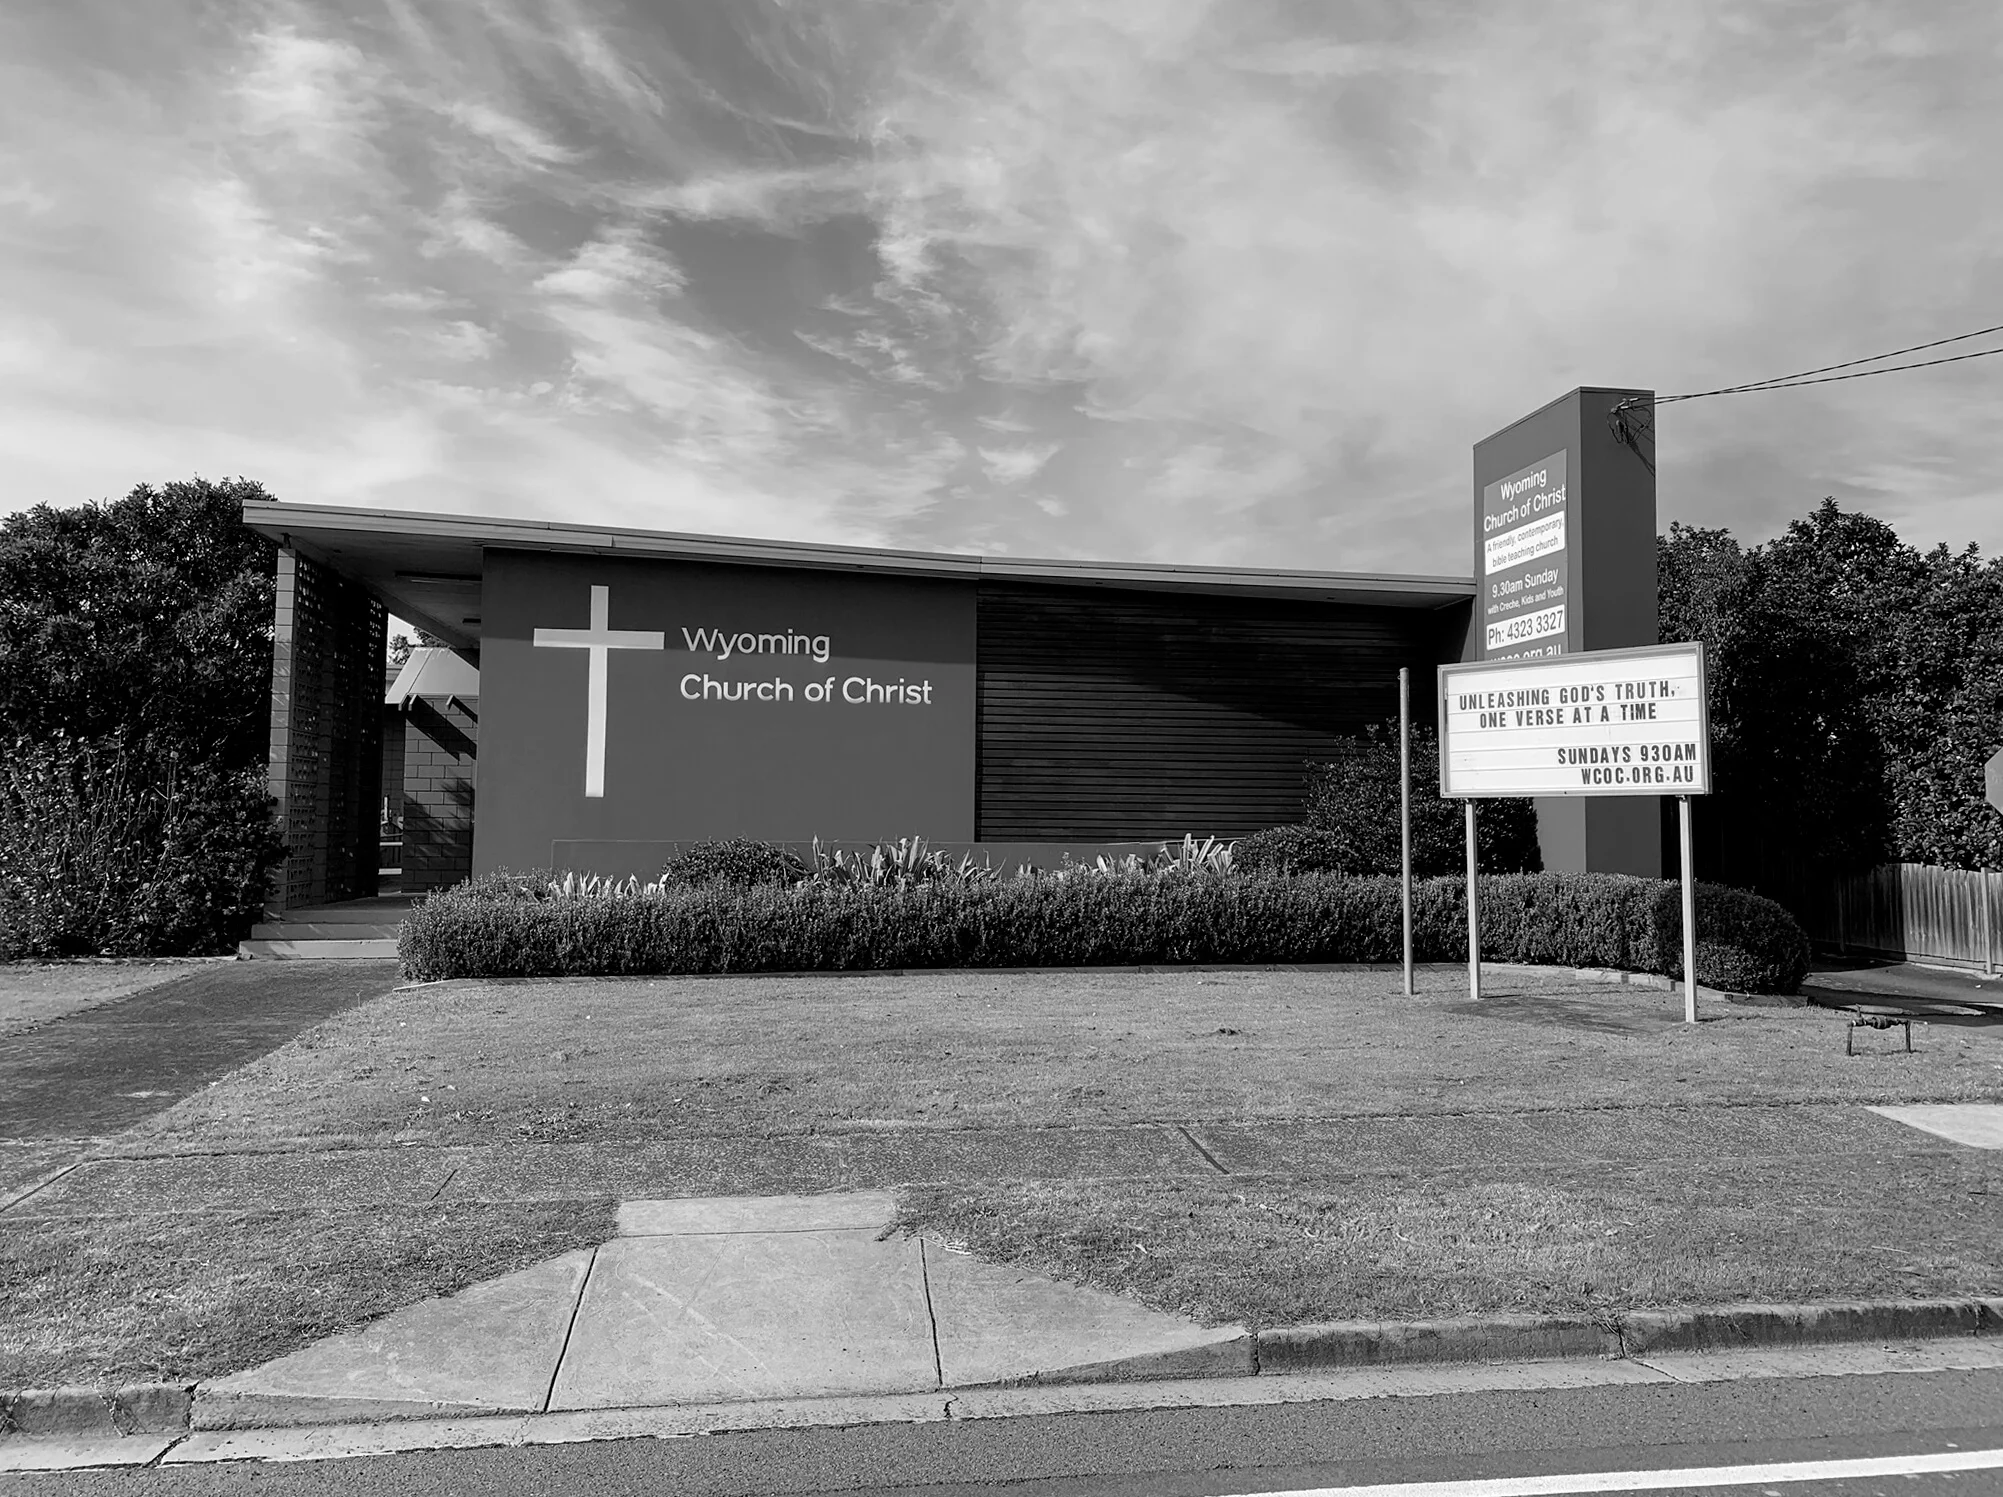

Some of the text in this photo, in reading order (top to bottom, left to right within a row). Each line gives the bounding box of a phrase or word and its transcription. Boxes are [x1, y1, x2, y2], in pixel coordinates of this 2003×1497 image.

[1500, 469, 1546, 501] Wyoming
[1484, 483, 1566, 532] Church of Christ
[1487, 543, 1492, 553] A
[1517, 518, 1562, 542] contemporary
[1492, 535, 1559, 567] bible teaching church
[1492, 568, 1559, 598] 9.30am Sunday
[1487, 603, 1499, 615] with
[1521, 594, 1534, 606] Kids
[1534, 590, 1546, 602] and
[1547, 585, 1564, 599] Youth
[1488, 610, 1563, 645] Ph: 4323 3327
[681, 627, 830, 663] Wyoming
[680, 673, 932, 705] Church of Christ
[1459, 680, 1675, 711] UNLEASHING GOD'S TRUTH,
[1480, 702, 1657, 729] ONE VERSE AT A TIME
[1558, 743, 1696, 765] SUNDAYS 930AM
[1581, 765, 1693, 785] WCOC.ORG.AU
